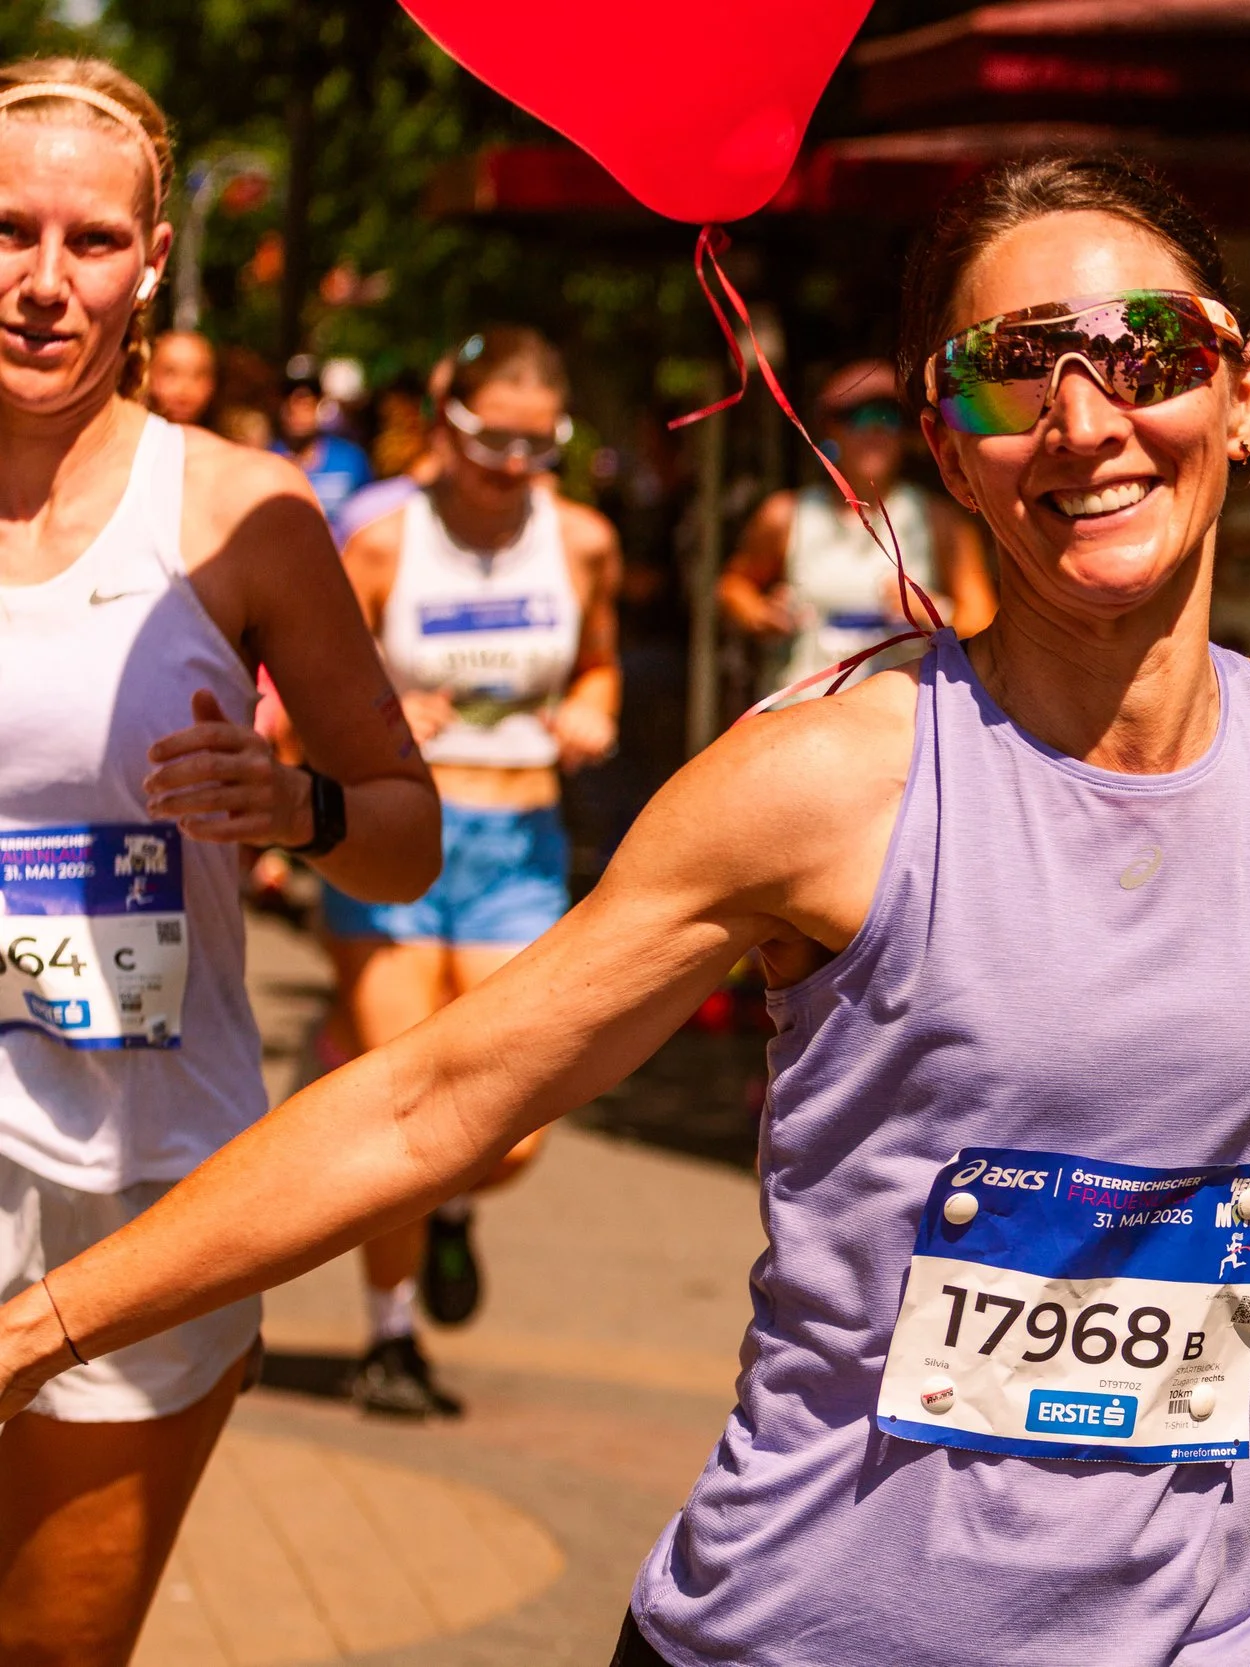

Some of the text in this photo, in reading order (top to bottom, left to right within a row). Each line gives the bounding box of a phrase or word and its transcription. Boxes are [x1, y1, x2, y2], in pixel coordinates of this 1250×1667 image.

[25, 863, 56, 880] MAI
[114, 948, 136, 971] C
[1093, 1208, 1194, 1229] 31. MAI 2026
[942, 1285, 1171, 1369] 17968
[1183, 1331, 1206, 1361] B
[924, 1357, 950, 1370] Silvia
[1201, 1374, 1225, 1384] rechts
[1169, 1389, 1193, 1399] 10km
[1038, 1402, 1102, 1425] ERSTE
[1171, 1447, 1238, 1459] #hereformore
